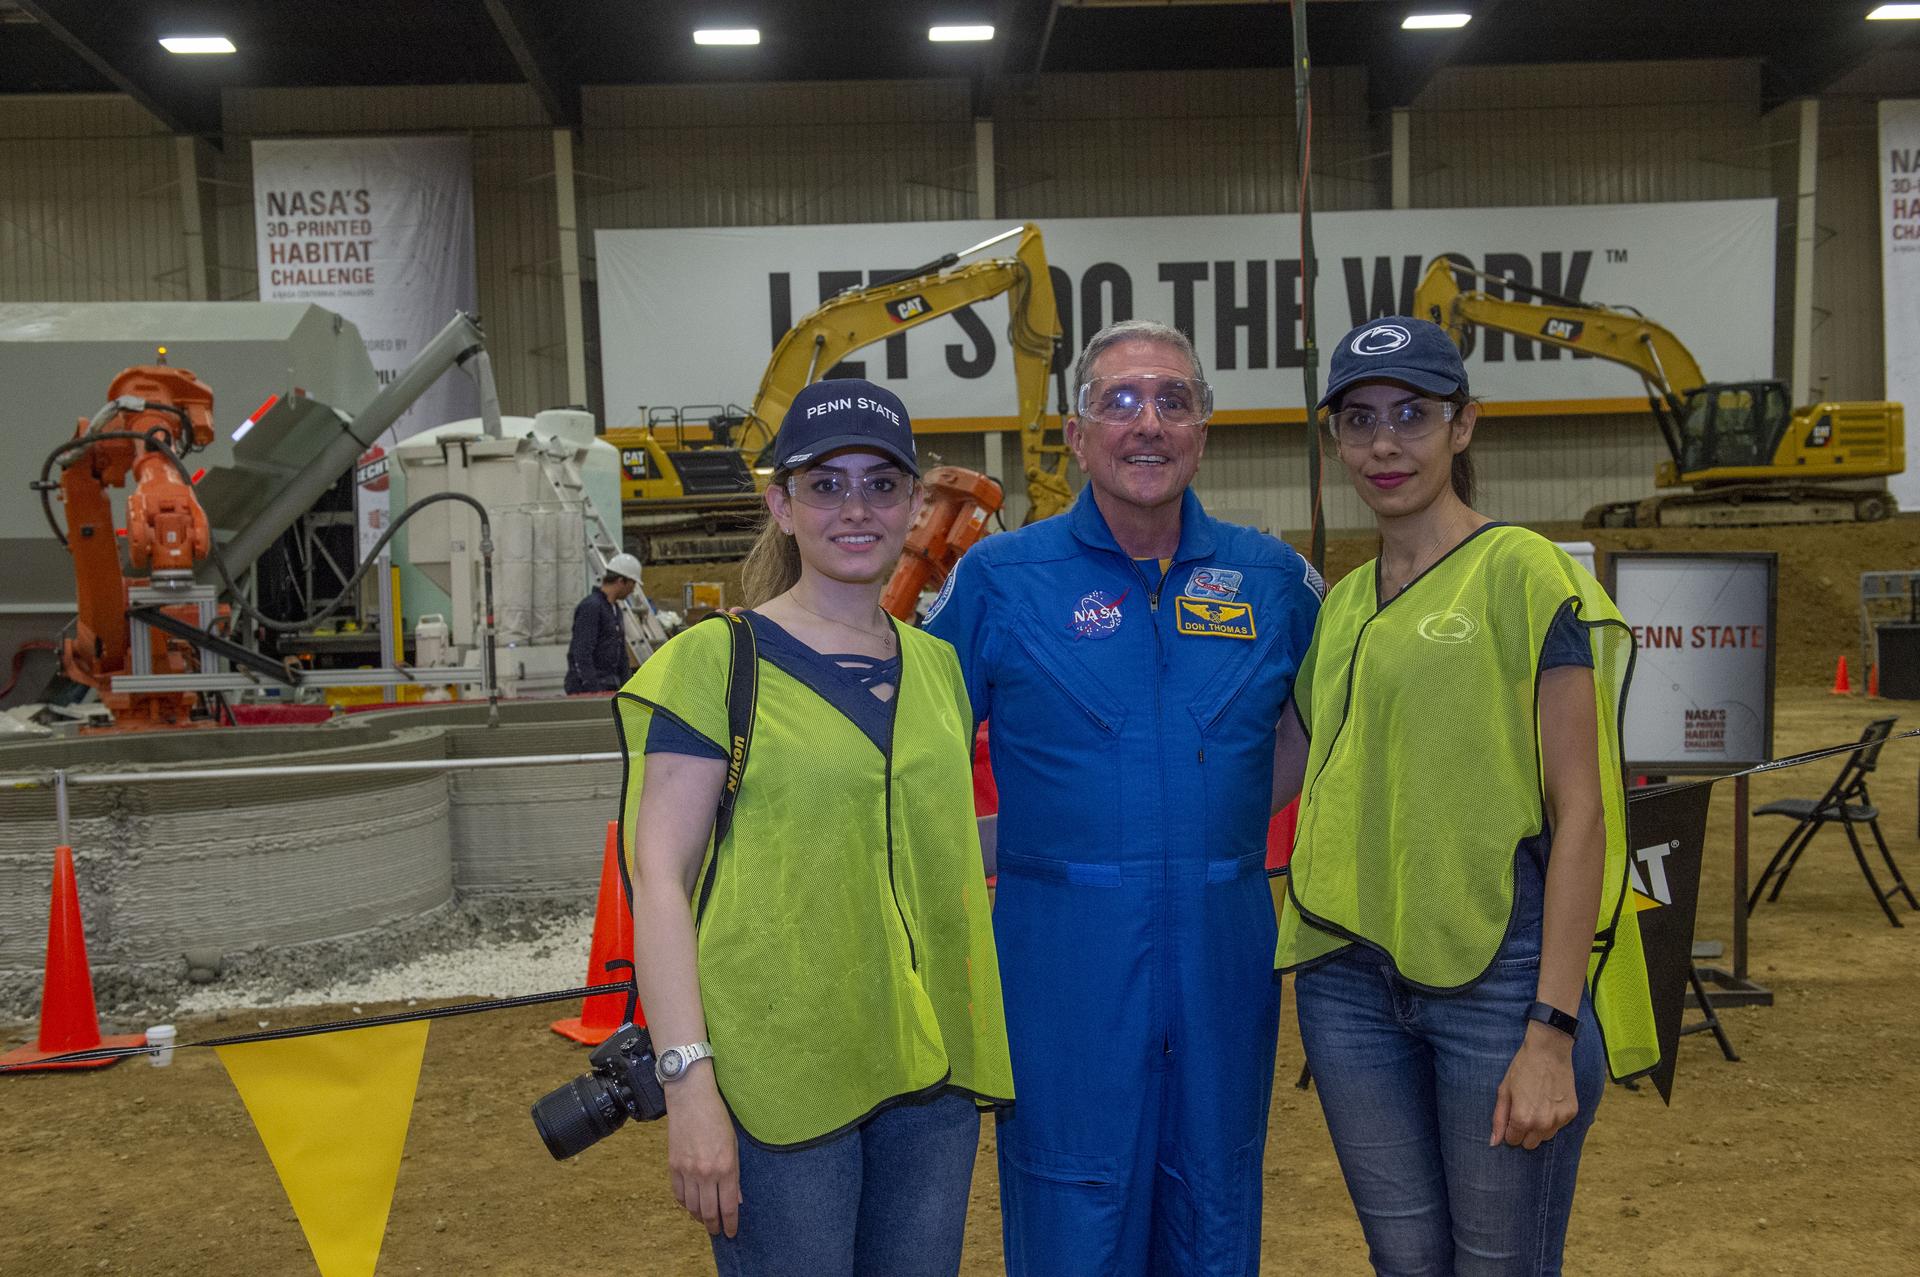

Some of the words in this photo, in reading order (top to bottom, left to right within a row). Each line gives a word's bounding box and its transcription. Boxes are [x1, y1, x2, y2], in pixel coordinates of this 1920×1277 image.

[267, 189, 371, 216] NASA'S
[267, 219, 372, 237] 3D-PRINTED
[270, 241, 373, 264] HABITAT
[271, 267, 375, 286] CHALLENGE
[897, 297, 923, 320] CAT
[1547, 319, 1574, 339] CAT
[807, 398, 852, 419] PENN
[857, 397, 900, 426] STATE
[623, 451, 644, 466] CAT
[1073, 606, 1123, 624] NASA
[1185, 622, 1205, 631] DON
[1209, 624, 1248, 635] THOMAS
[1690, 626, 1765, 649] STATE
[1685, 709, 1727, 721] NASA'S
[727, 735, 745, 793] Nikon
